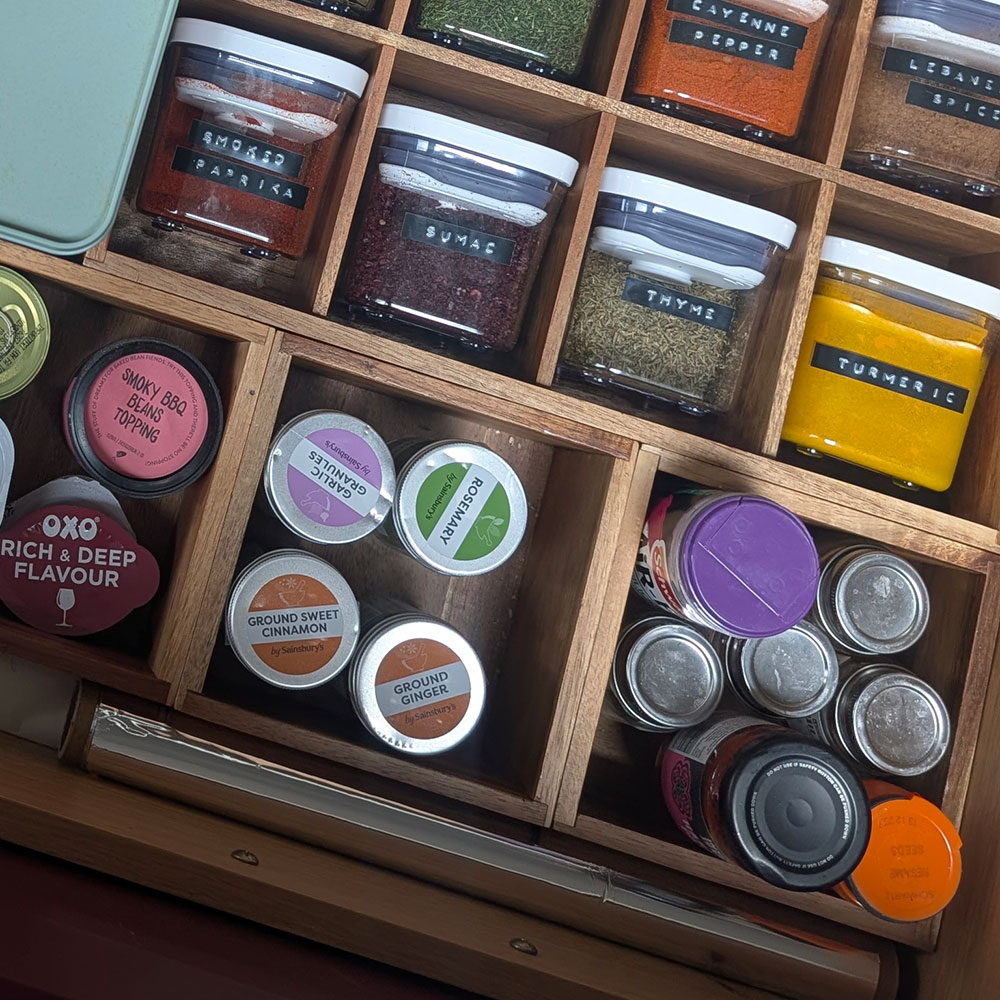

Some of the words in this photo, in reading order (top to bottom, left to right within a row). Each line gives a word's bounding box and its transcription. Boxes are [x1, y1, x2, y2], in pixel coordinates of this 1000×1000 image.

[694, 30, 779, 61] PEPPER
[909, 59, 1000, 96] LEBANE
[203, 131, 284, 166] SMOKED
[194, 159, 292, 198] PAPRIKA
[425, 225, 496, 255] SUMAC
[647, 289, 715, 320] THYME
[122, 368, 161, 400] SMOKY
[160, 391, 188, 416] BBQ
[838, 357, 956, 404] TURMERIC
[127, 394, 164, 422] BEANS
[94, 427, 103, 439] THE
[325, 440, 361, 470] Sainsbury's
[308, 450, 366, 496] GRANULES
[310, 466, 352, 499] GARLIC
[360, 464, 370, 476] by
[446, 472, 458, 482] by
[426, 481, 452, 520] Sainsbury's
[440, 476, 484, 545] ROSEMARY
[42, 514, 98, 541] OXO
[1, 539, 52, 560] RICH
[60, 550, 70, 562] &
[78, 546, 136, 568] DEEP
[14, 562, 120, 588] FLAVOUR
[248, 613, 298, 626] GROUND
[300, 610, 339, 620] SWEET
[262, 623, 328, 638] CINNAMON
[271, 647, 280, 657] by
[282, 644, 324, 654] Sainsbury's
[394, 672, 448, 694] GROUND
[400, 684, 448, 705] GINGER
[404, 714, 415, 726] by
[416, 703, 456, 720] Sainsbury's
